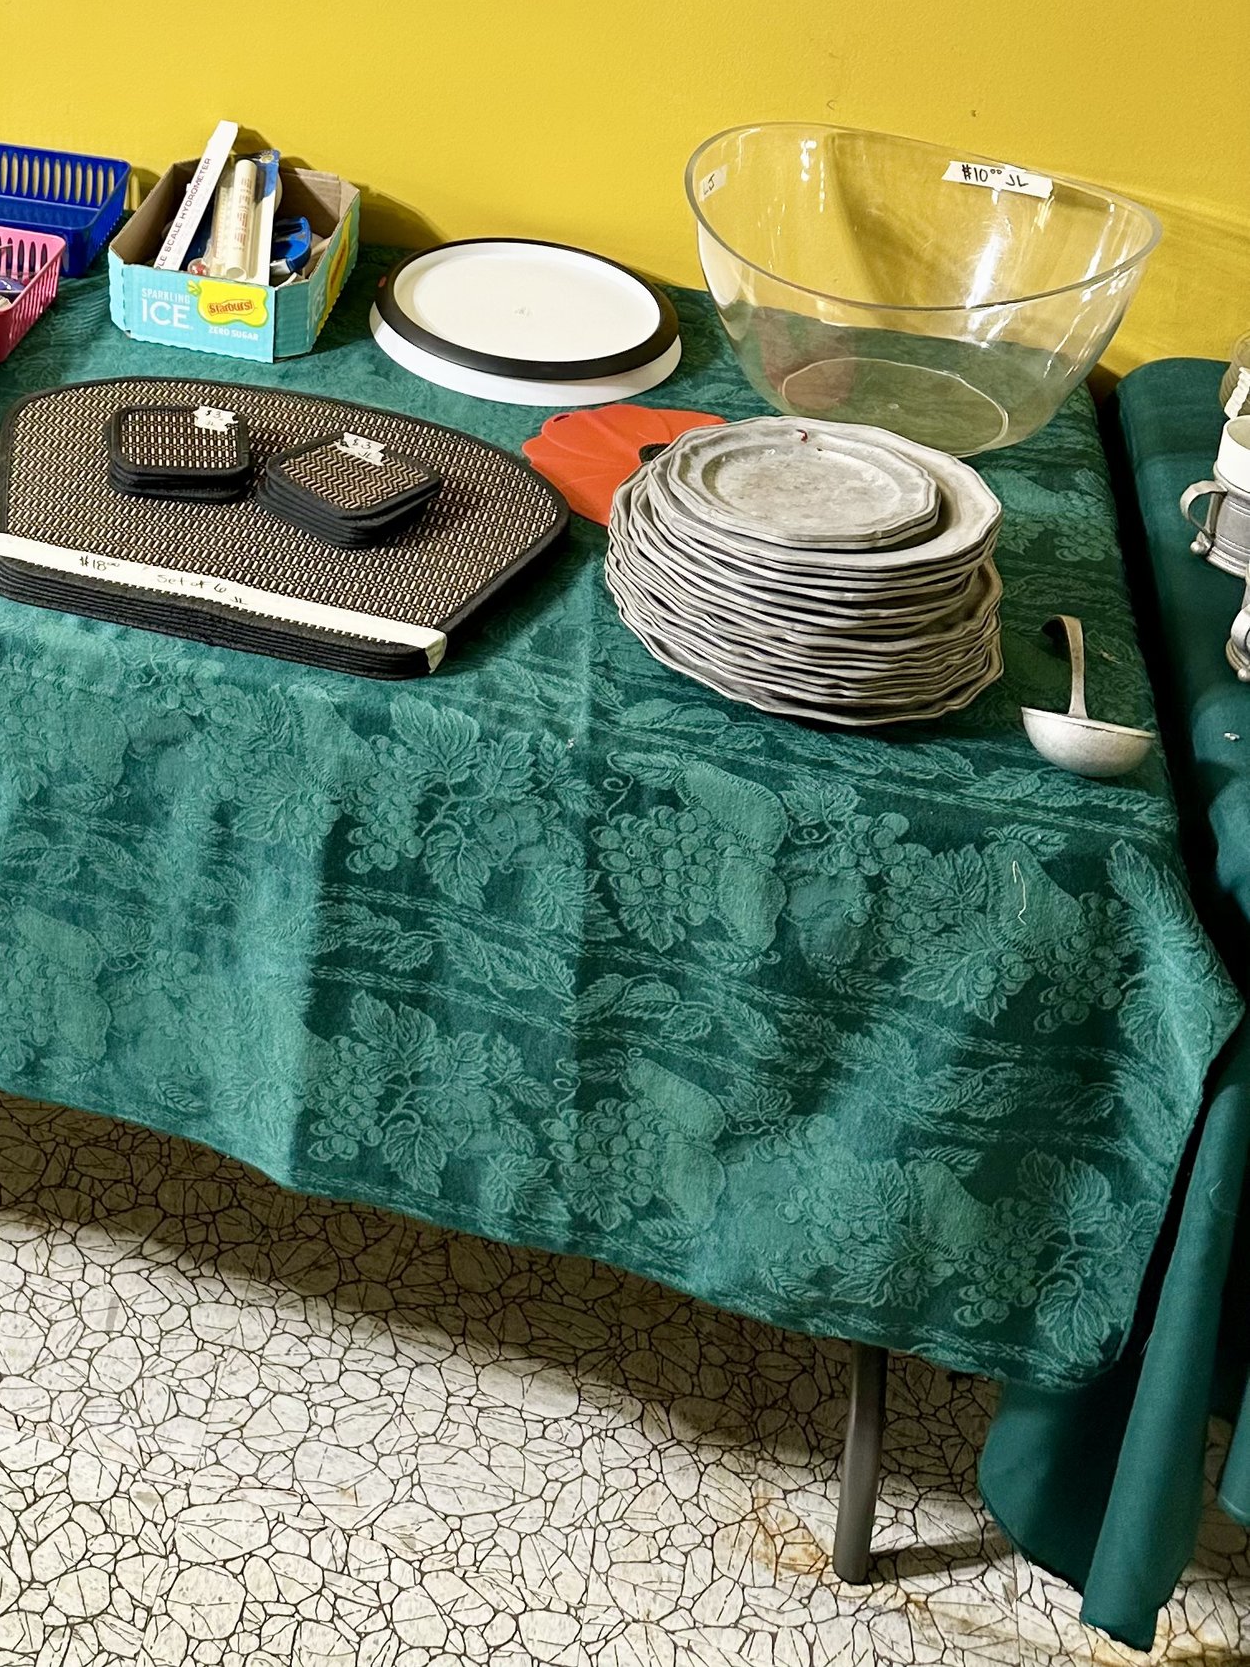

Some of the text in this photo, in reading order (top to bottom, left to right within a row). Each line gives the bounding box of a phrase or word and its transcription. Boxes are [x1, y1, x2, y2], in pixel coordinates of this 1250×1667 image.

[164, 221, 183, 253] SCALE
[180, 157, 213, 220] HYDROMETER
[142, 288, 191, 304] SPARKLING
[142, 298, 191, 330] ICE
[209, 326, 259, 341] ZERO SUGAR
